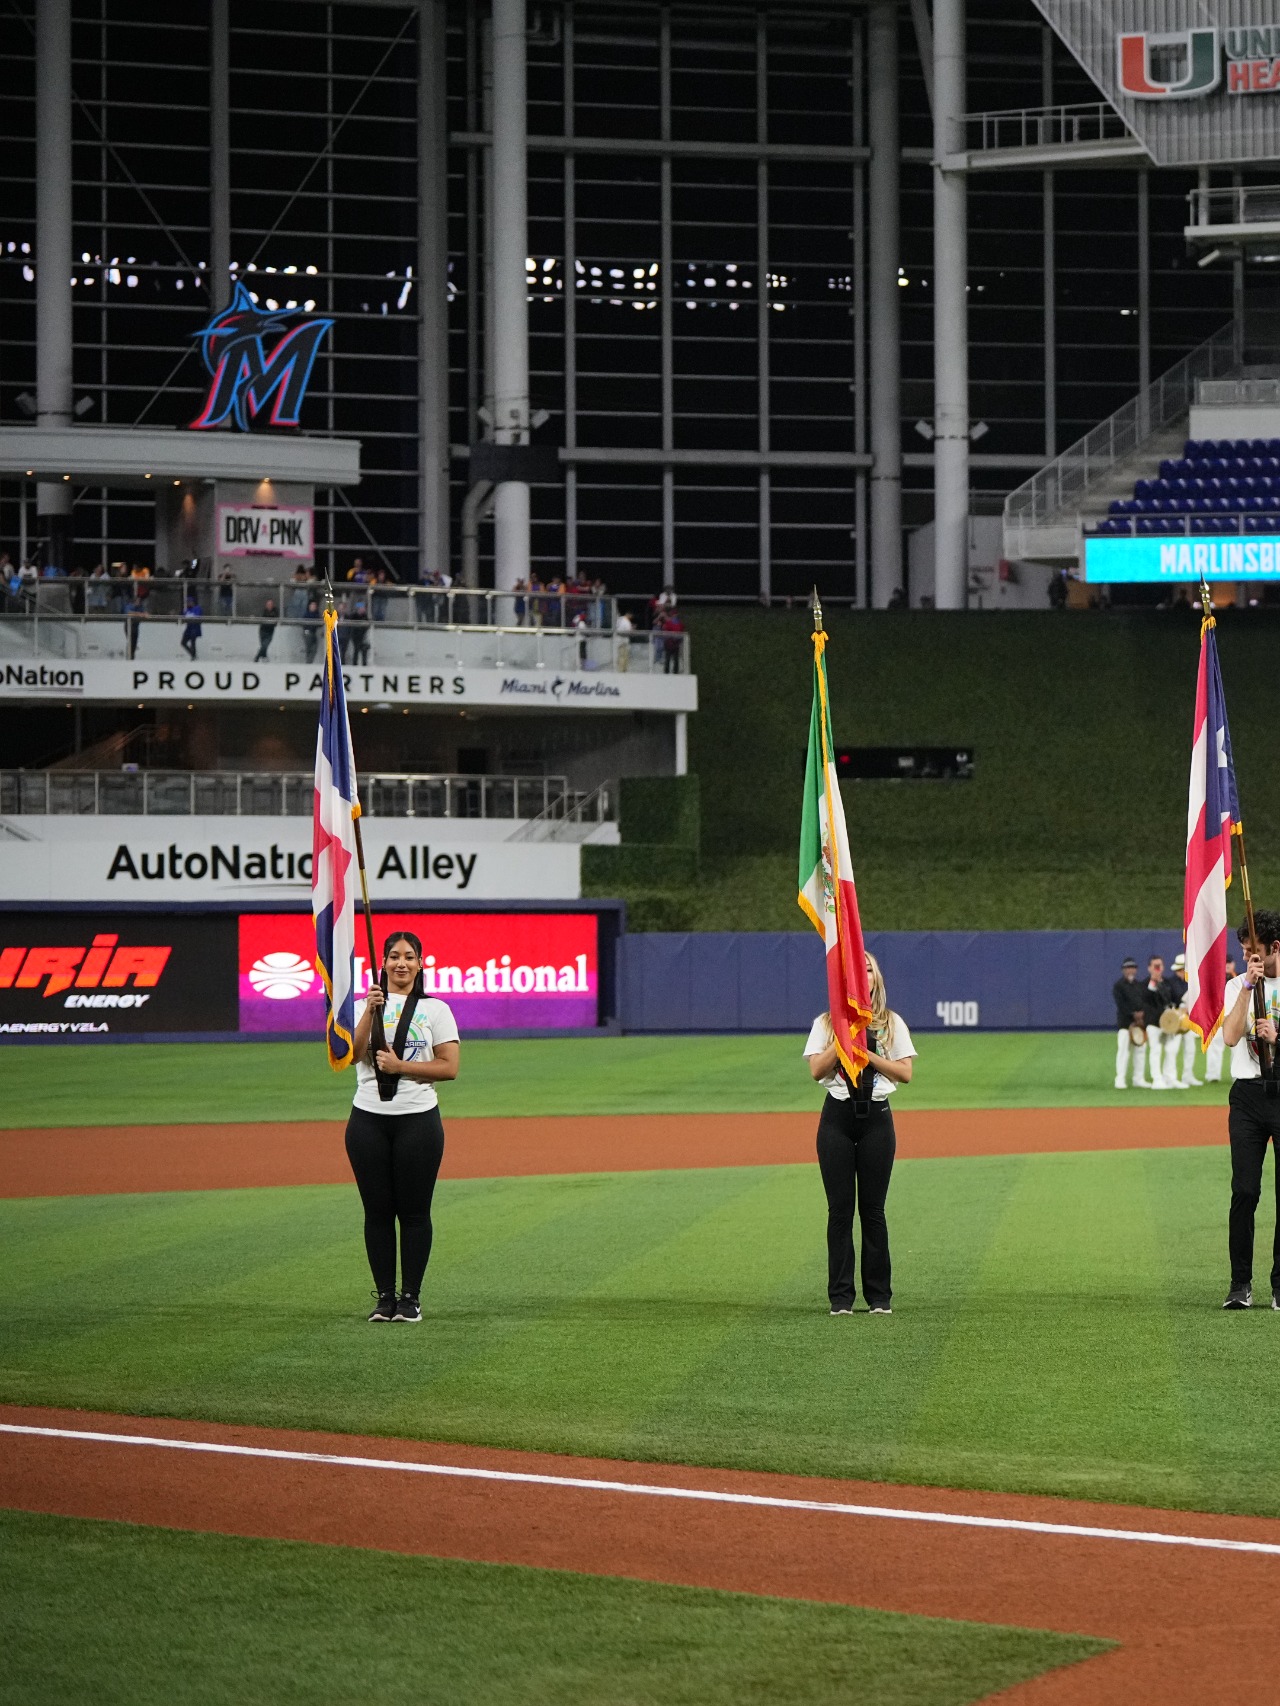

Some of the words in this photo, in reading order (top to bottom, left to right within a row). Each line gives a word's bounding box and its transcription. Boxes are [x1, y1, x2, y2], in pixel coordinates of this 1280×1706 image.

[225, 515, 260, 544] DRV
[269, 517, 304, 546] PNK
[133, 671, 260, 690] PROUD
[500, 679, 546, 694] Miami
[568, 680, 621, 697] Marlins
[107, 844, 313, 880] AutoNatio
[377, 845, 478, 890] Alley
[64, 994, 150, 1009] ENERGY
[936, 1001, 979, 1027] 400
